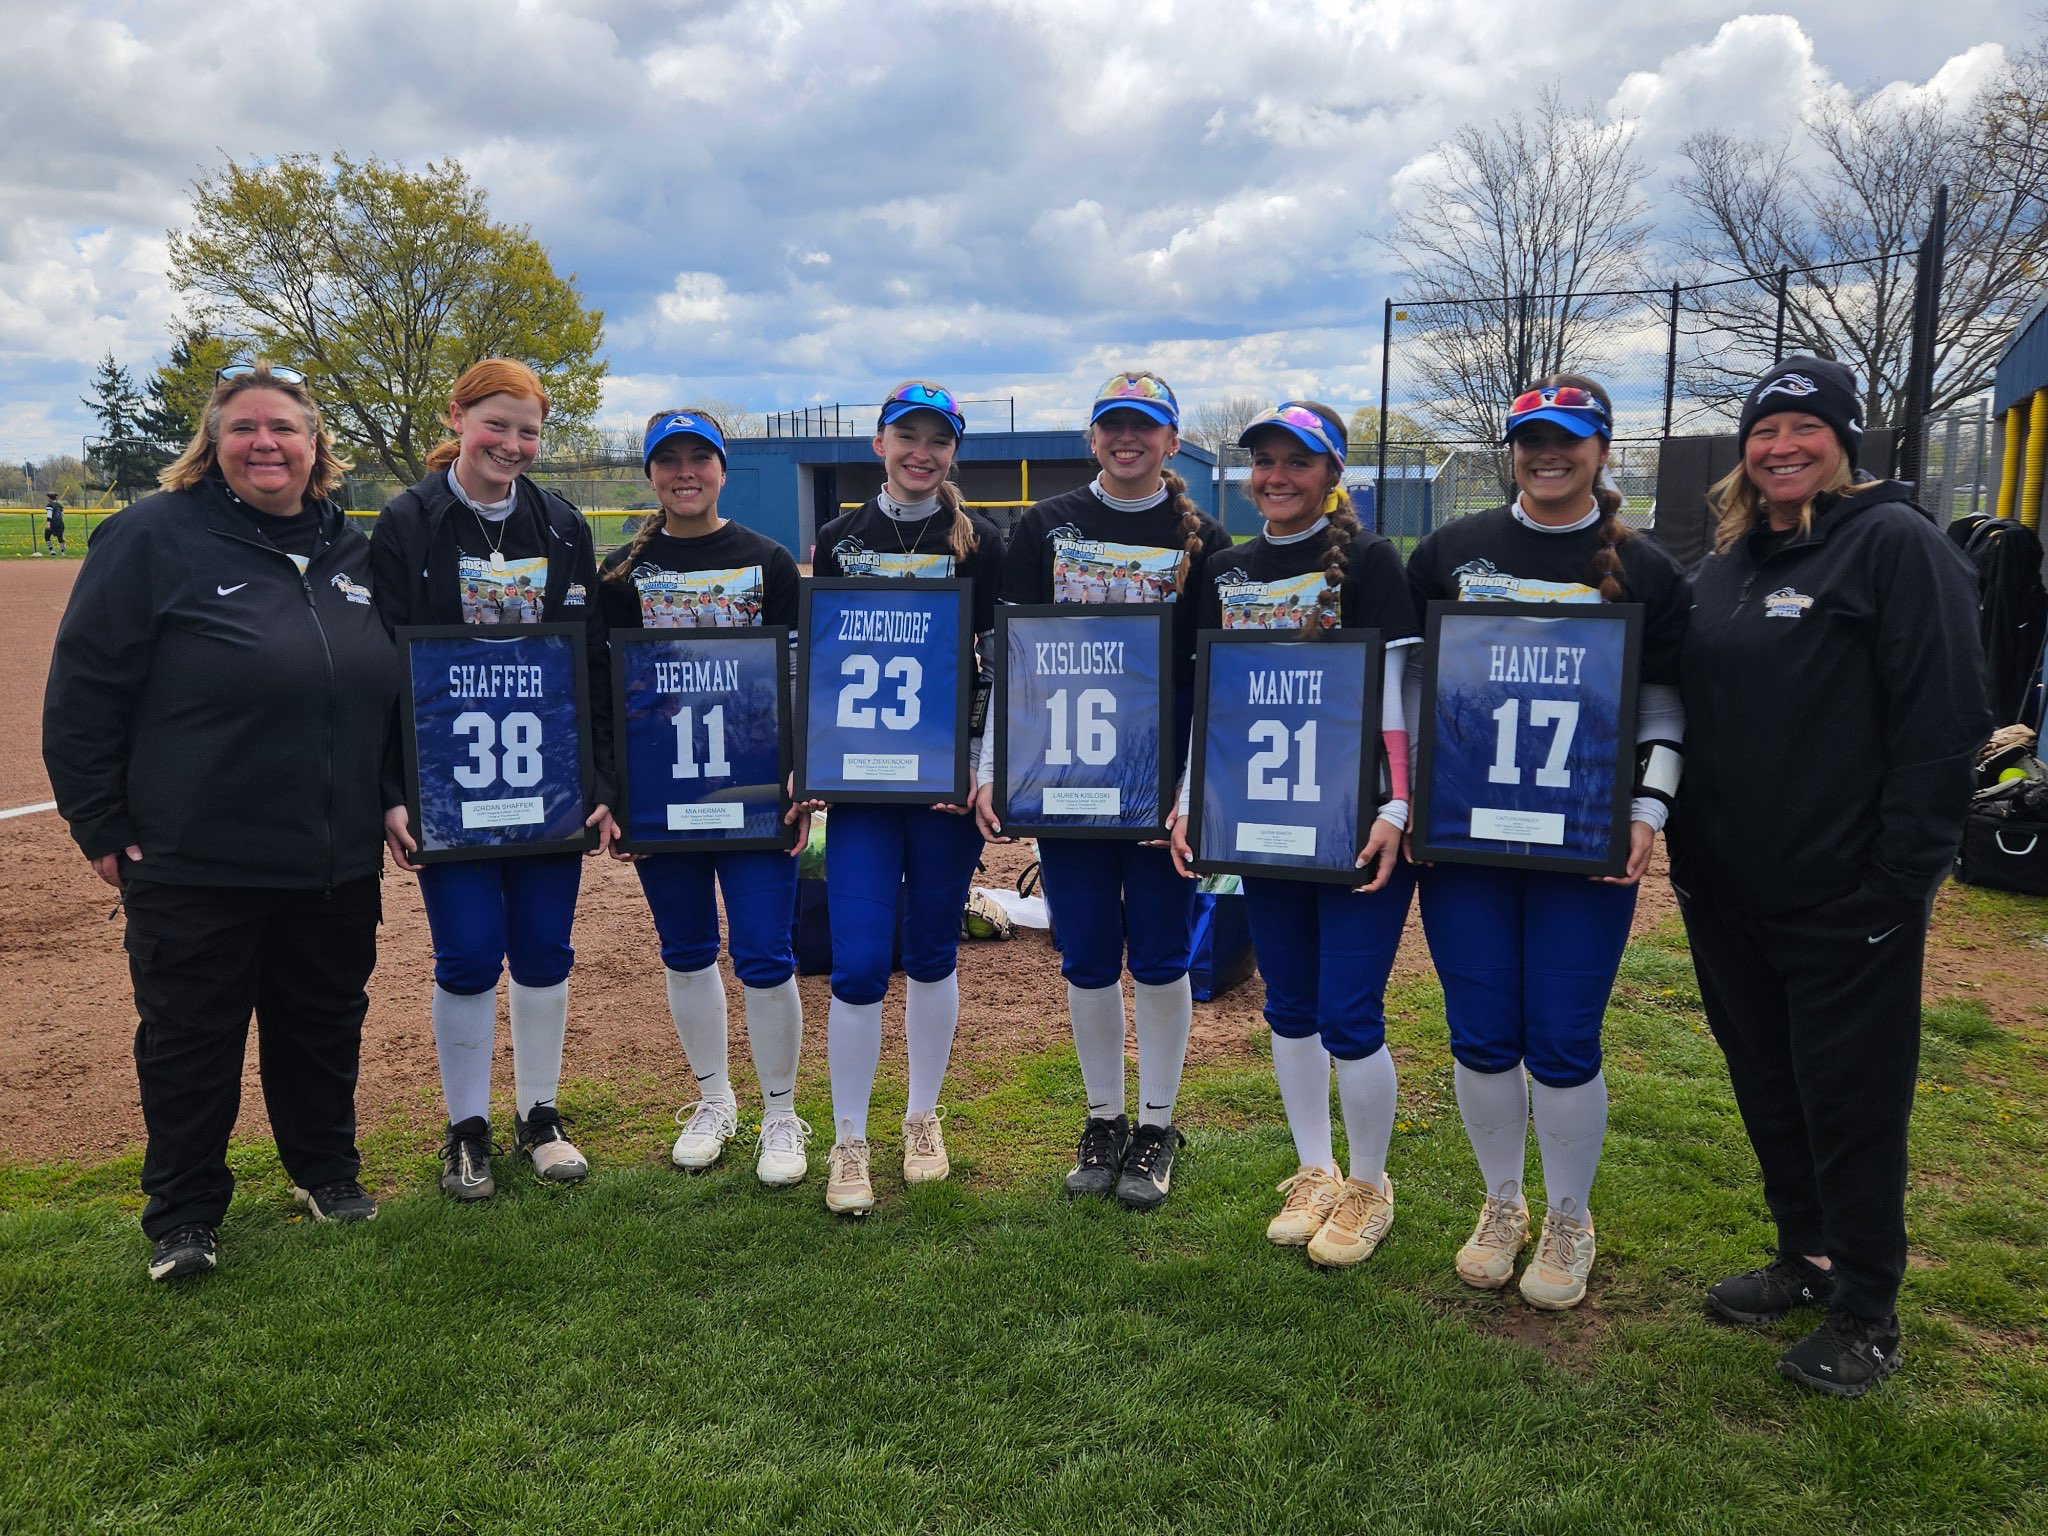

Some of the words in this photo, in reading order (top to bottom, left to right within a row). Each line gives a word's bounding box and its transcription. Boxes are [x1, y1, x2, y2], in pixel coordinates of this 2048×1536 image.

[1054, 539, 1104, 555] THUNDER
[459, 559, 490, 573] NDER
[1219, 584, 1269, 598] THUNDER
[1459, 575, 1520, 591] THUNDER
[838, 610, 931, 643] ZIEMENDORF
[1036, 642, 1123, 675] KISLOSKI
[1489, 645, 1586, 684] HANLEY
[450, 665, 543, 697] SHAFFER
[655, 660, 738, 693] HERMAN
[836, 655, 922, 730] 23
[1249, 671, 1323, 704] MANTH
[671, 705, 730, 778] 11
[1046, 689, 1116, 765] 16
[1489, 699, 1579, 787] 17
[453, 712, 543, 788] 38
[1248, 720, 1320, 801] 21
[472, 803, 500, 812] JORDAN
[502, 801, 534, 810] SHAFFER
